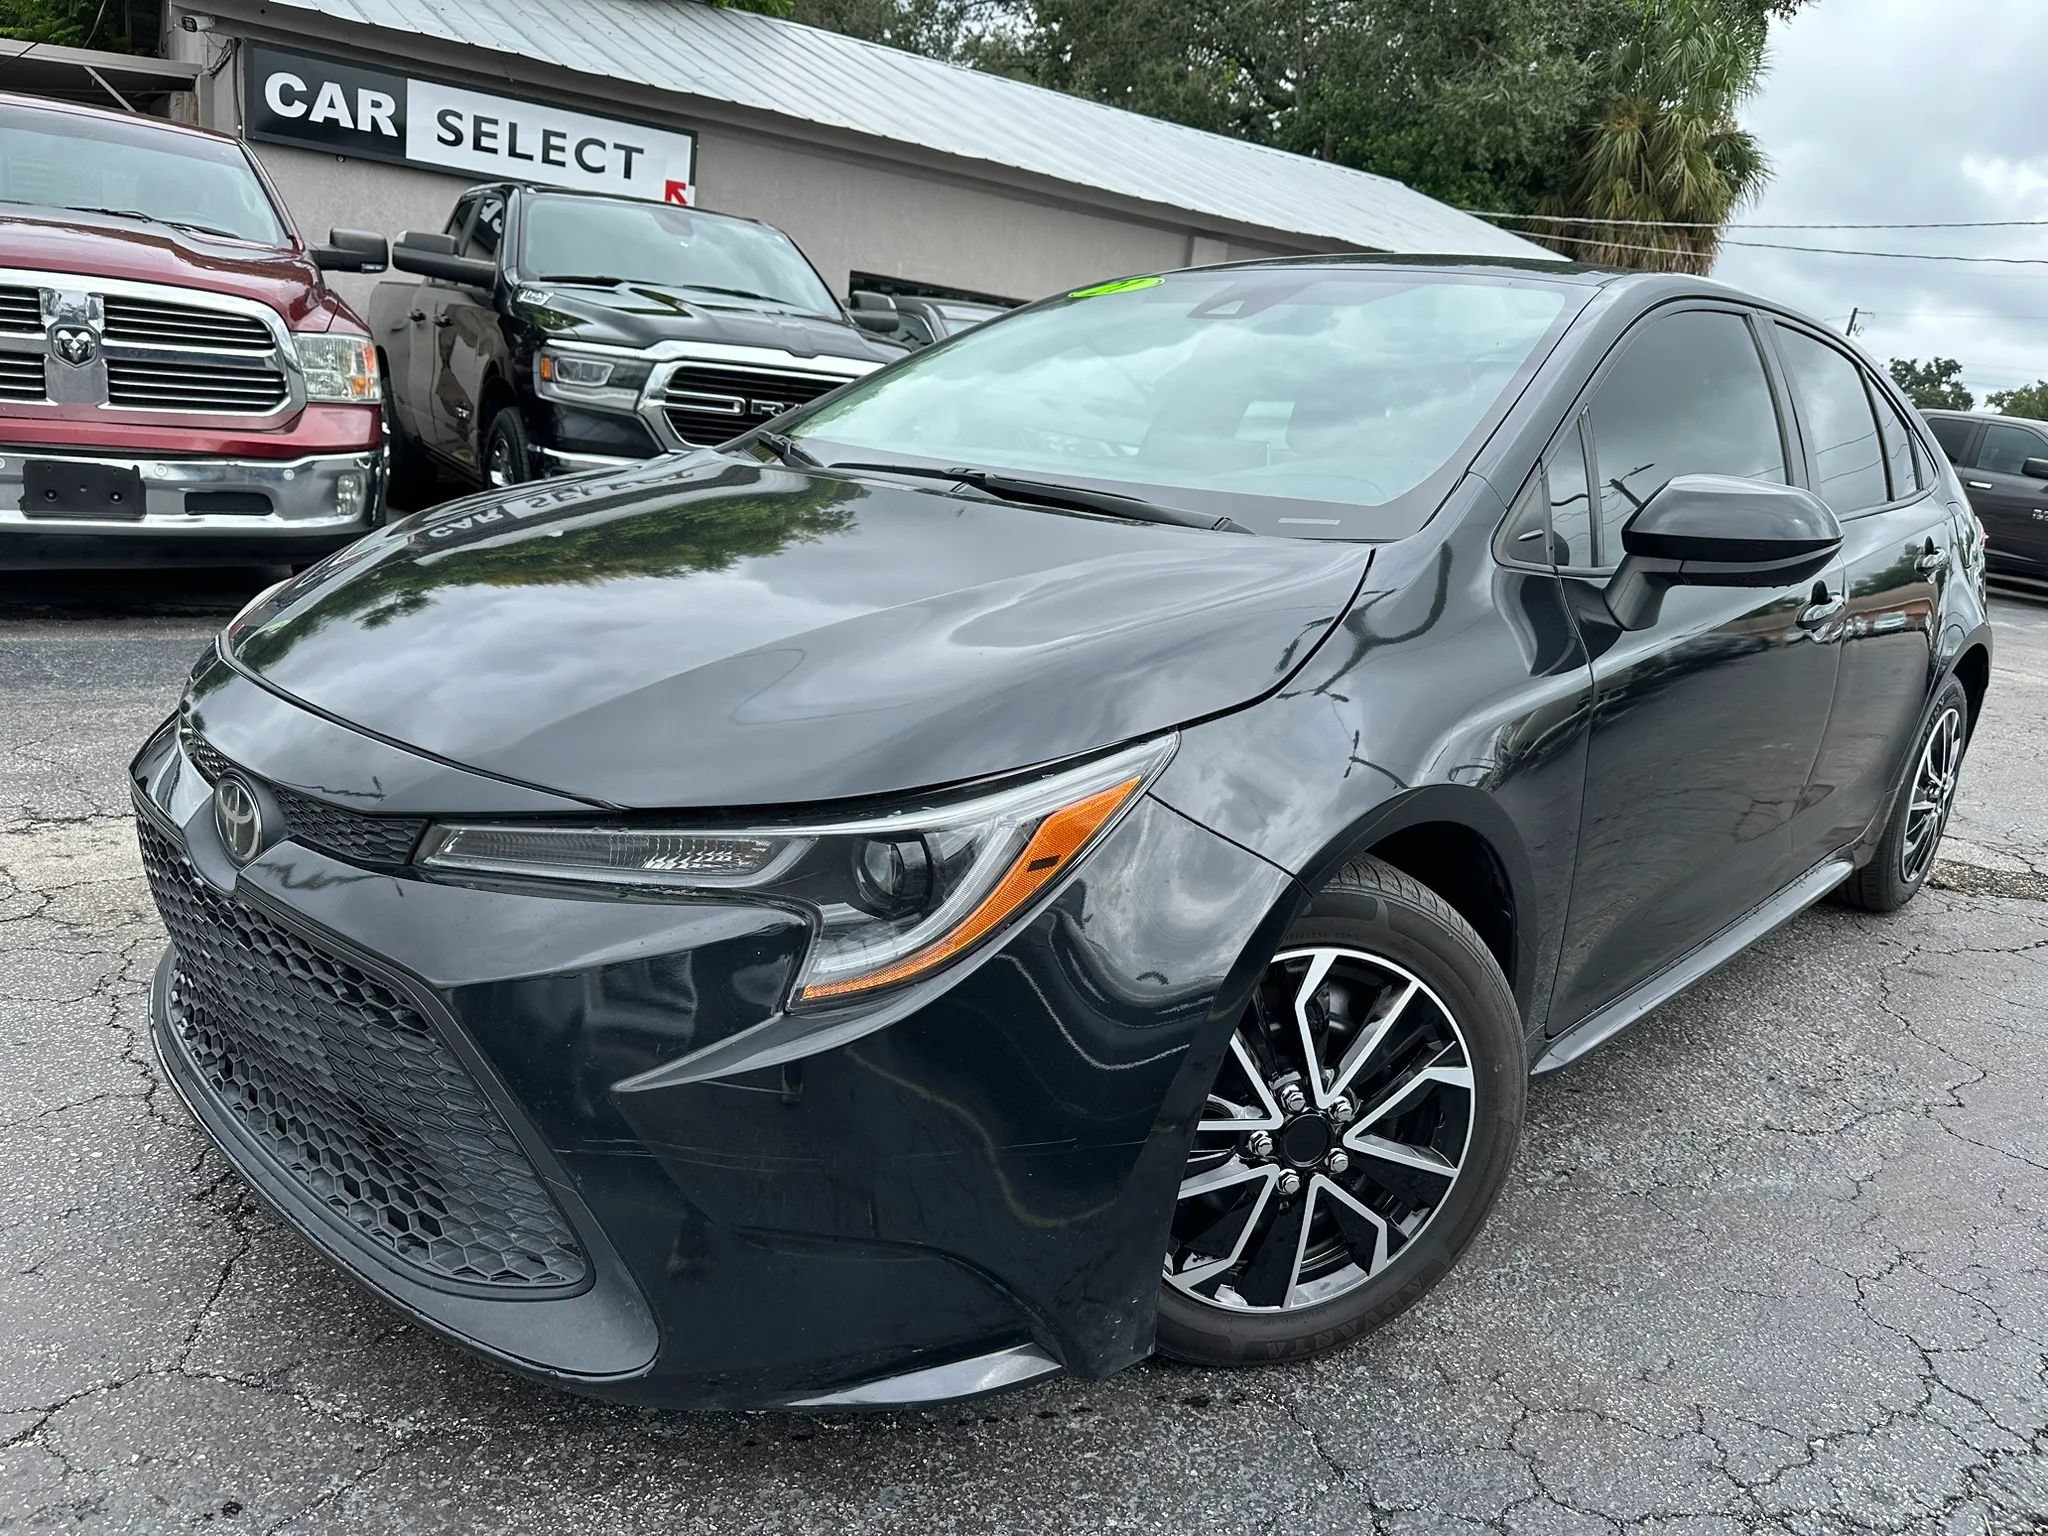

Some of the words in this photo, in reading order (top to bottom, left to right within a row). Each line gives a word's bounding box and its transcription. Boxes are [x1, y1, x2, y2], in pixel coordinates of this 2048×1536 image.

[264, 72, 398, 137] CAR
[436, 109, 644, 180] SELECT
[1264, 1275, 1427, 1360] ADVANTA
